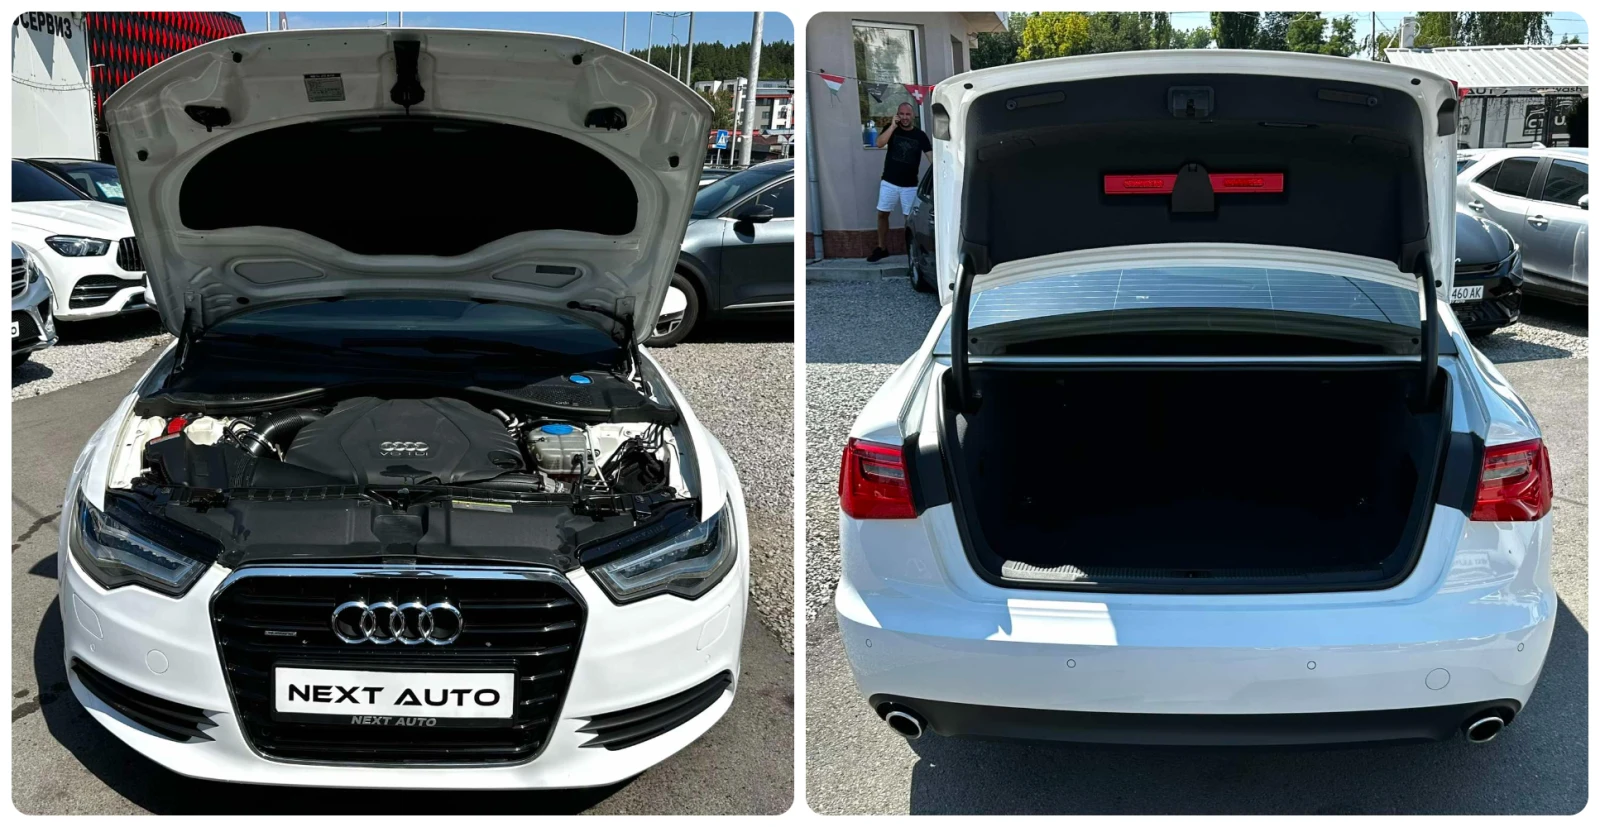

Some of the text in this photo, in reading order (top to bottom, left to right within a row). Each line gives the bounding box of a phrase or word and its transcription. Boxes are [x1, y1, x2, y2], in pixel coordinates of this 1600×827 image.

[1452, 287, 1482, 299] 460 AK
[288, 684, 501, 707] NEXT AUTO
[351, 715, 437, 727] NEXT AUTO
